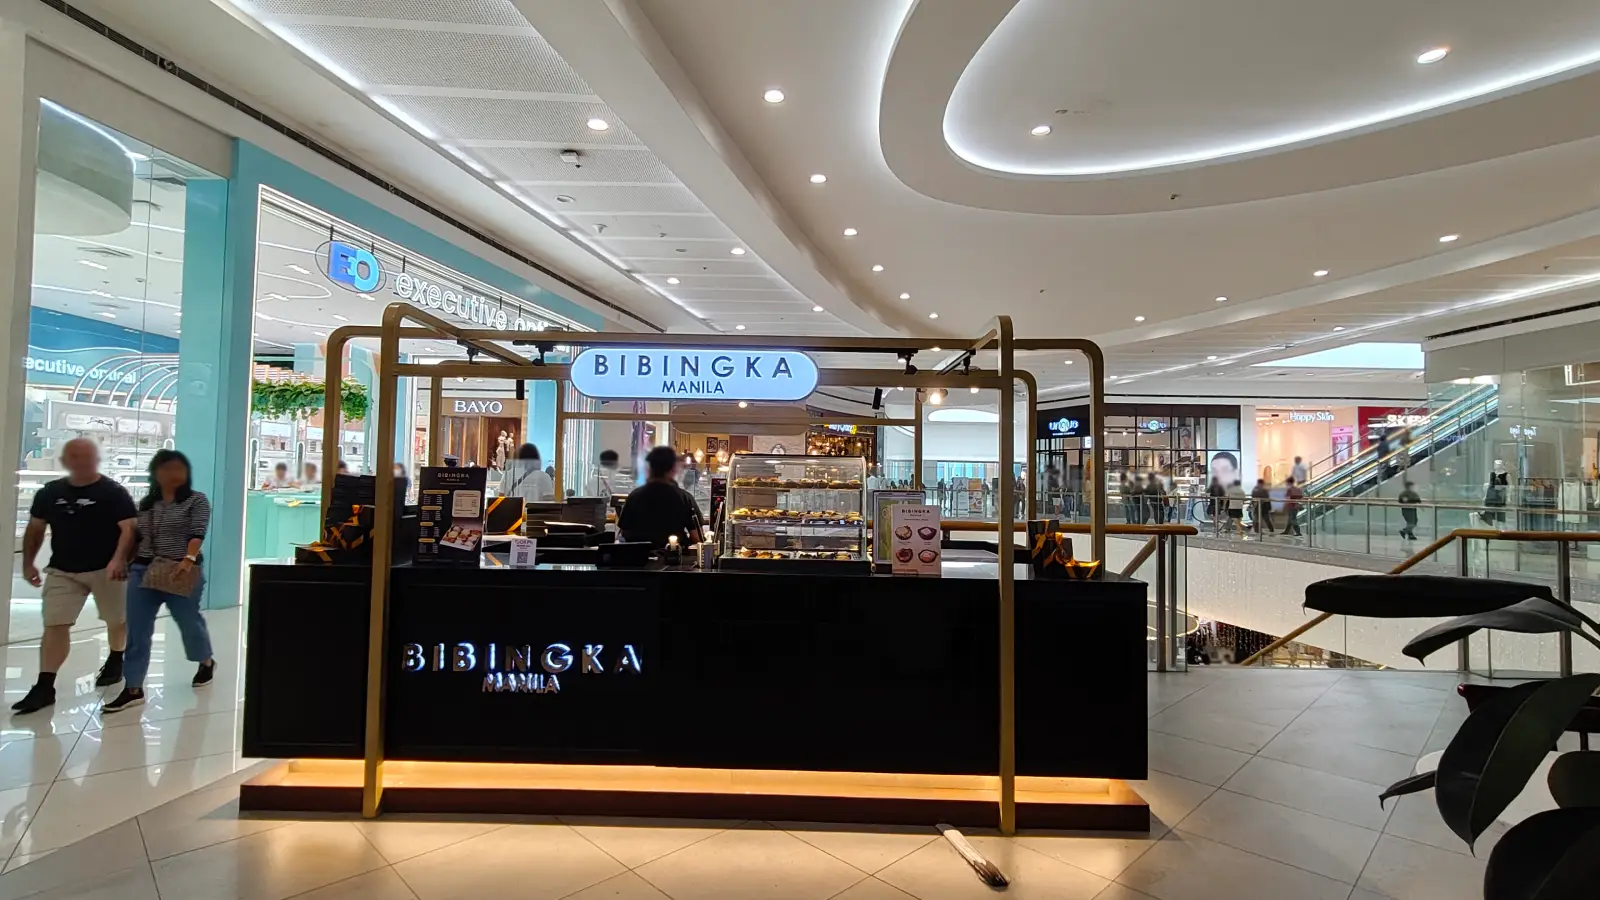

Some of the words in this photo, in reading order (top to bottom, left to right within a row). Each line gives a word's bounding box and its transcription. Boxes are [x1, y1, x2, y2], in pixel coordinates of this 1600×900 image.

[395, 272, 508, 331] executive
[23, 356, 85, 377] ecutive
[594, 354, 793, 378] BIBINGKA
[661, 380, 725, 394] MANILA
[454, 400, 504, 414] BAYO
[402, 643, 642, 673] BIBINGKA
[481, 672, 561, 694] MANILA
